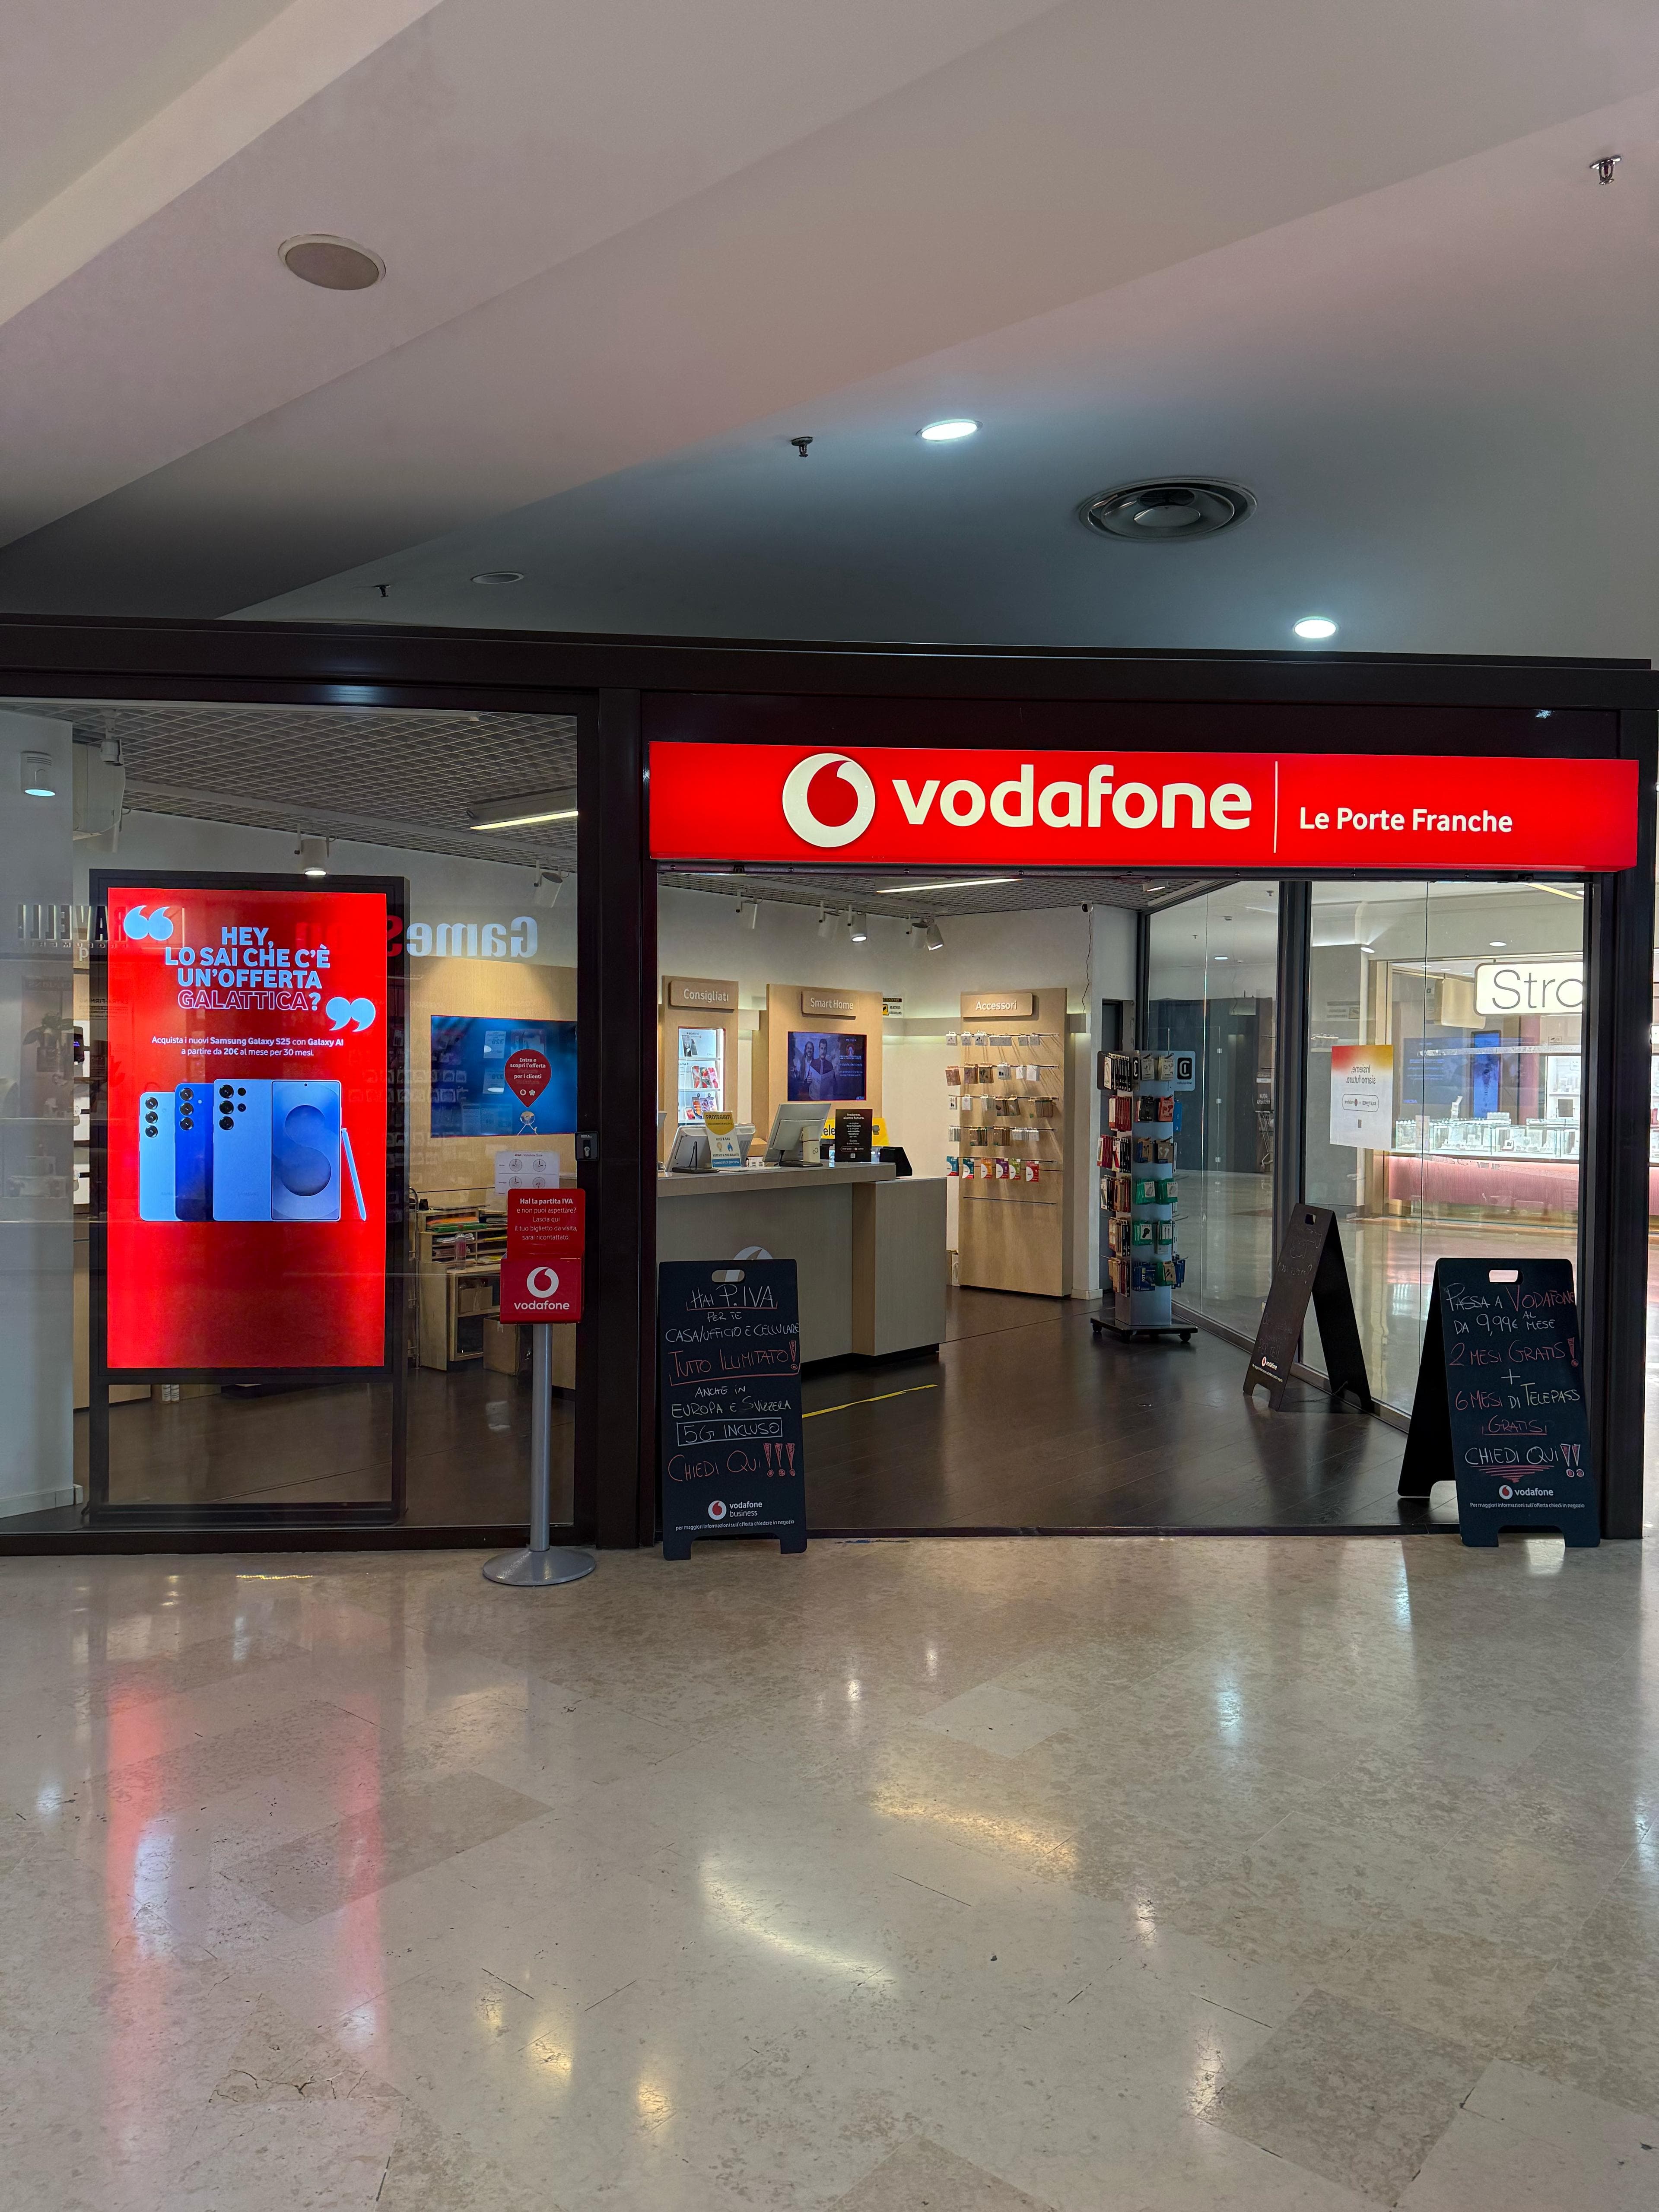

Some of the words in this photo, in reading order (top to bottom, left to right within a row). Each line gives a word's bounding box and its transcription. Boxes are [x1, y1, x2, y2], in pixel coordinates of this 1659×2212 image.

[891, 764, 1252, 830] vodafone
[1300, 807, 1329, 830] Le
[1337, 807, 1405, 830] Porte
[1412, 808, 1513, 833] Franche
[222, 926, 274, 949] HEY,
[165, 947, 195, 966] LO
[200, 947, 237, 966] SAI
[243, 948, 290, 967] CHE
[295, 944, 331, 968] C'È
[178, 968, 322, 989] UN'OFFERTA
[178, 989, 321, 1011] GALATTICA?
[683, 988, 728, 1003] Consigliati
[810, 997, 833, 1009] Smart
[833, 999, 854, 1010] Home
[975, 1001, 1017, 1010] Accessori
[152, 1036, 183, 1045] Acquista
[210, 1037, 247, 1046] Samsung
[248, 1037, 274, 1046] Galaxy
[308, 1039, 334, 1047] Galaxy
[188, 1048, 211, 1056] partire
[823, 1124, 835, 1136] ele
[1444, 1283, 1491, 1311] PASSA
[1495, 1296, 1503, 1309] A
[514, 1300, 570, 1310] vodafone
[707, 1312, 727, 1322] PER
[1522, 1311, 1536, 1319] AL
[753, 1323, 799, 1336] CELLULARE
[1454, 1320, 1469, 1335] DA
[1526, 1319, 1555, 1330] MESE
[1449, 1342, 1465, 1366] 2
[1470, 1349, 1502, 1366] MESI
[695, 1386, 728, 1398] ANCHE
[1455, 1390, 1468, 1411] 6
[1470, 1390, 1503, 1410] MESI
[1508, 1395, 1521, 1409] DI
[1520, 1382, 1580, 1406] TELEPASS
[672, 1401, 723, 1418] EUROPA
[730, 1403, 737, 1412] E
[684, 1424, 715, 1443] 5G
[724, 1422, 780, 1438] INCLUSO
[1465, 1447, 1519, 1465] CHIEDI
[1514, 1487, 1554, 1496] vodafone
